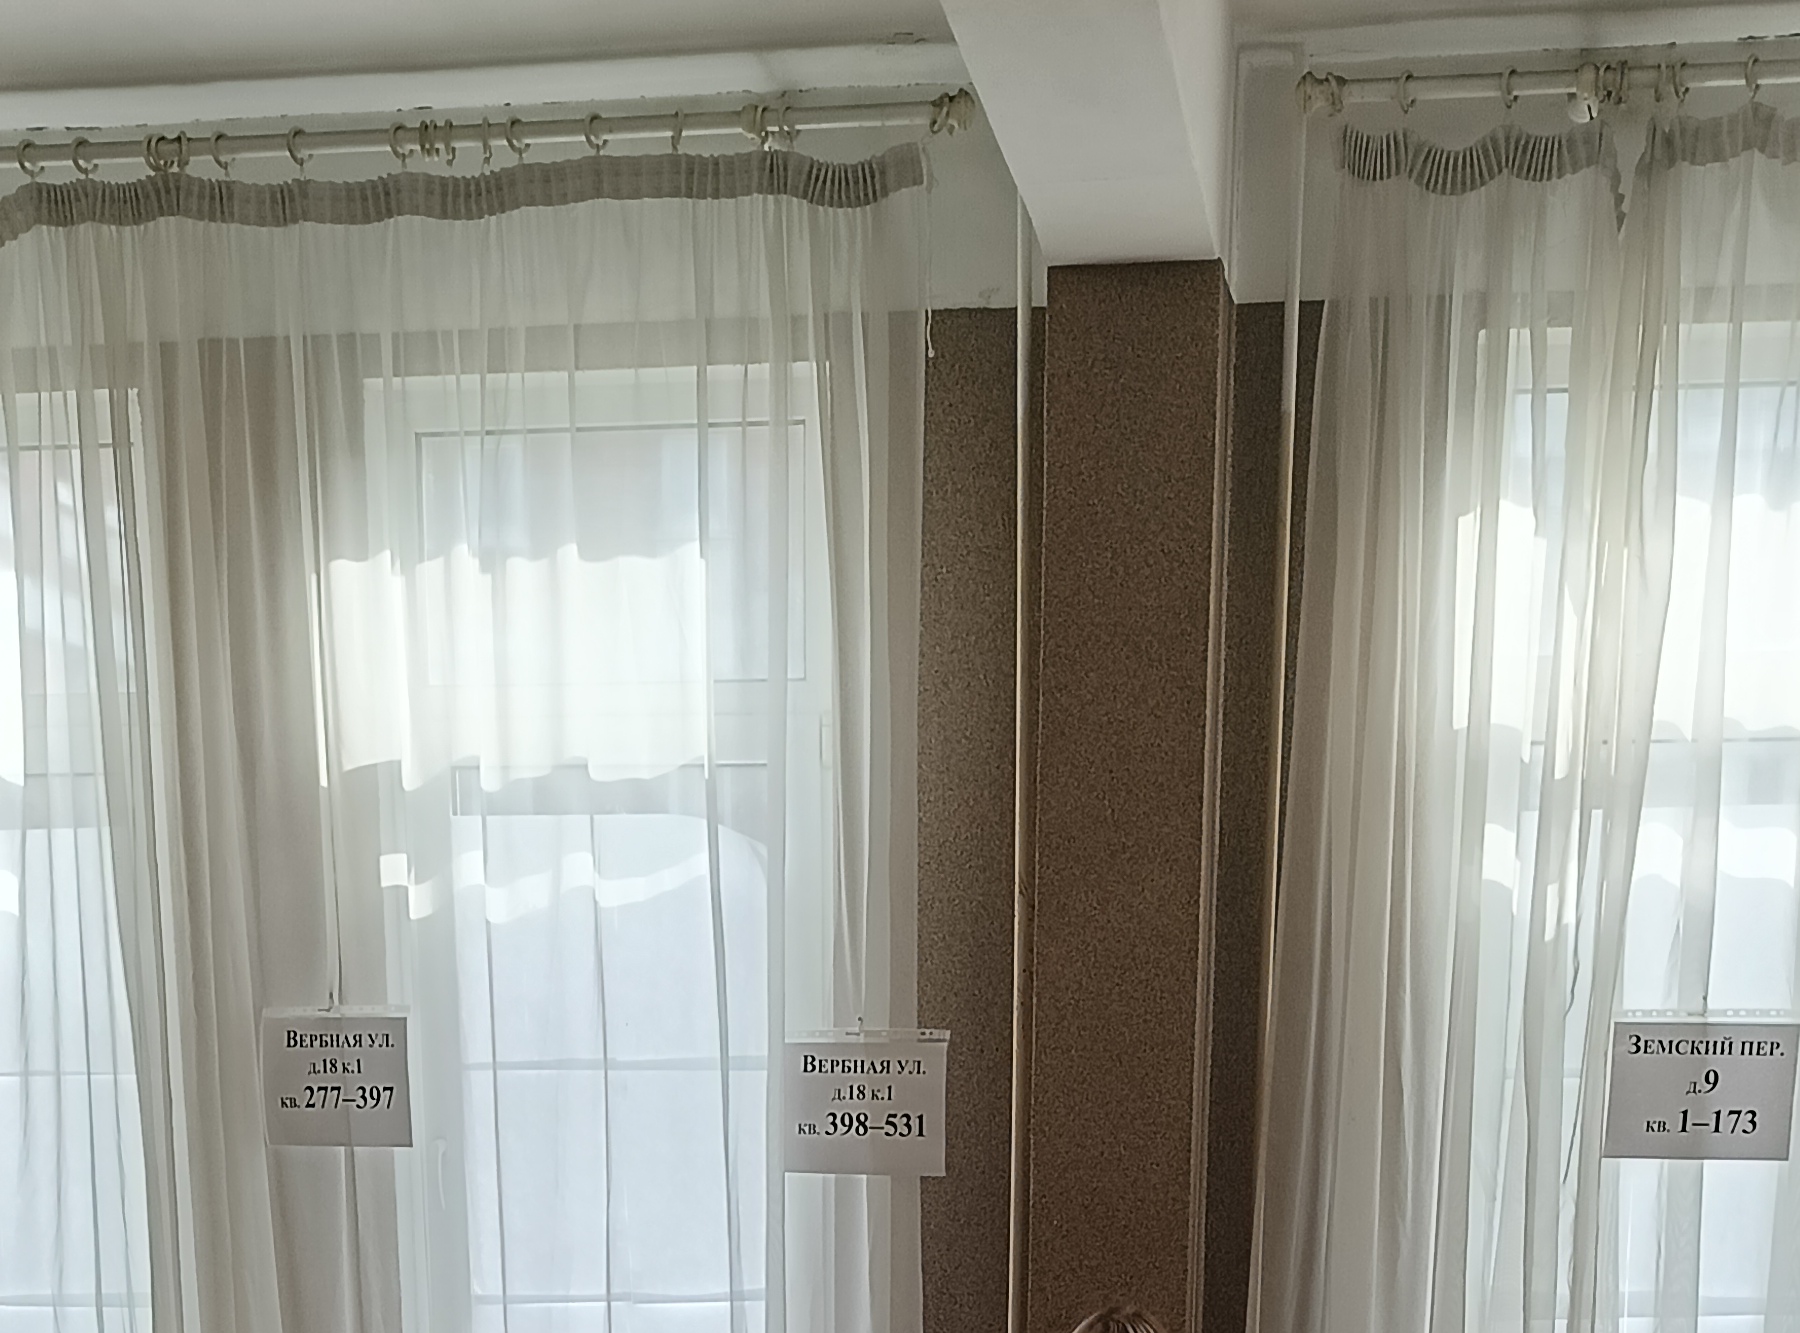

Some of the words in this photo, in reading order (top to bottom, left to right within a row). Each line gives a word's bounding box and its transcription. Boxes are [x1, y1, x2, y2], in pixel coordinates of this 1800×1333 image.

[307, 1058, 338, 1075] д.18
[341, 1058, 362, 1074] к.1
[831, 1084, 866, 1102] д.18
[871, 1084, 892, 1101] к.1
[1685, 1069, 1719, 1095] д.9
[280, 1096, 301, 1109] кв.
[303, 1086, 394, 1109] 277–397
[797, 1123, 820, 1136] кв.
[824, 1112, 926, 1138] 398–531
[1645, 1120, 1670, 1133] кв.
[1677, 1108, 1757, 1134] 1–173
